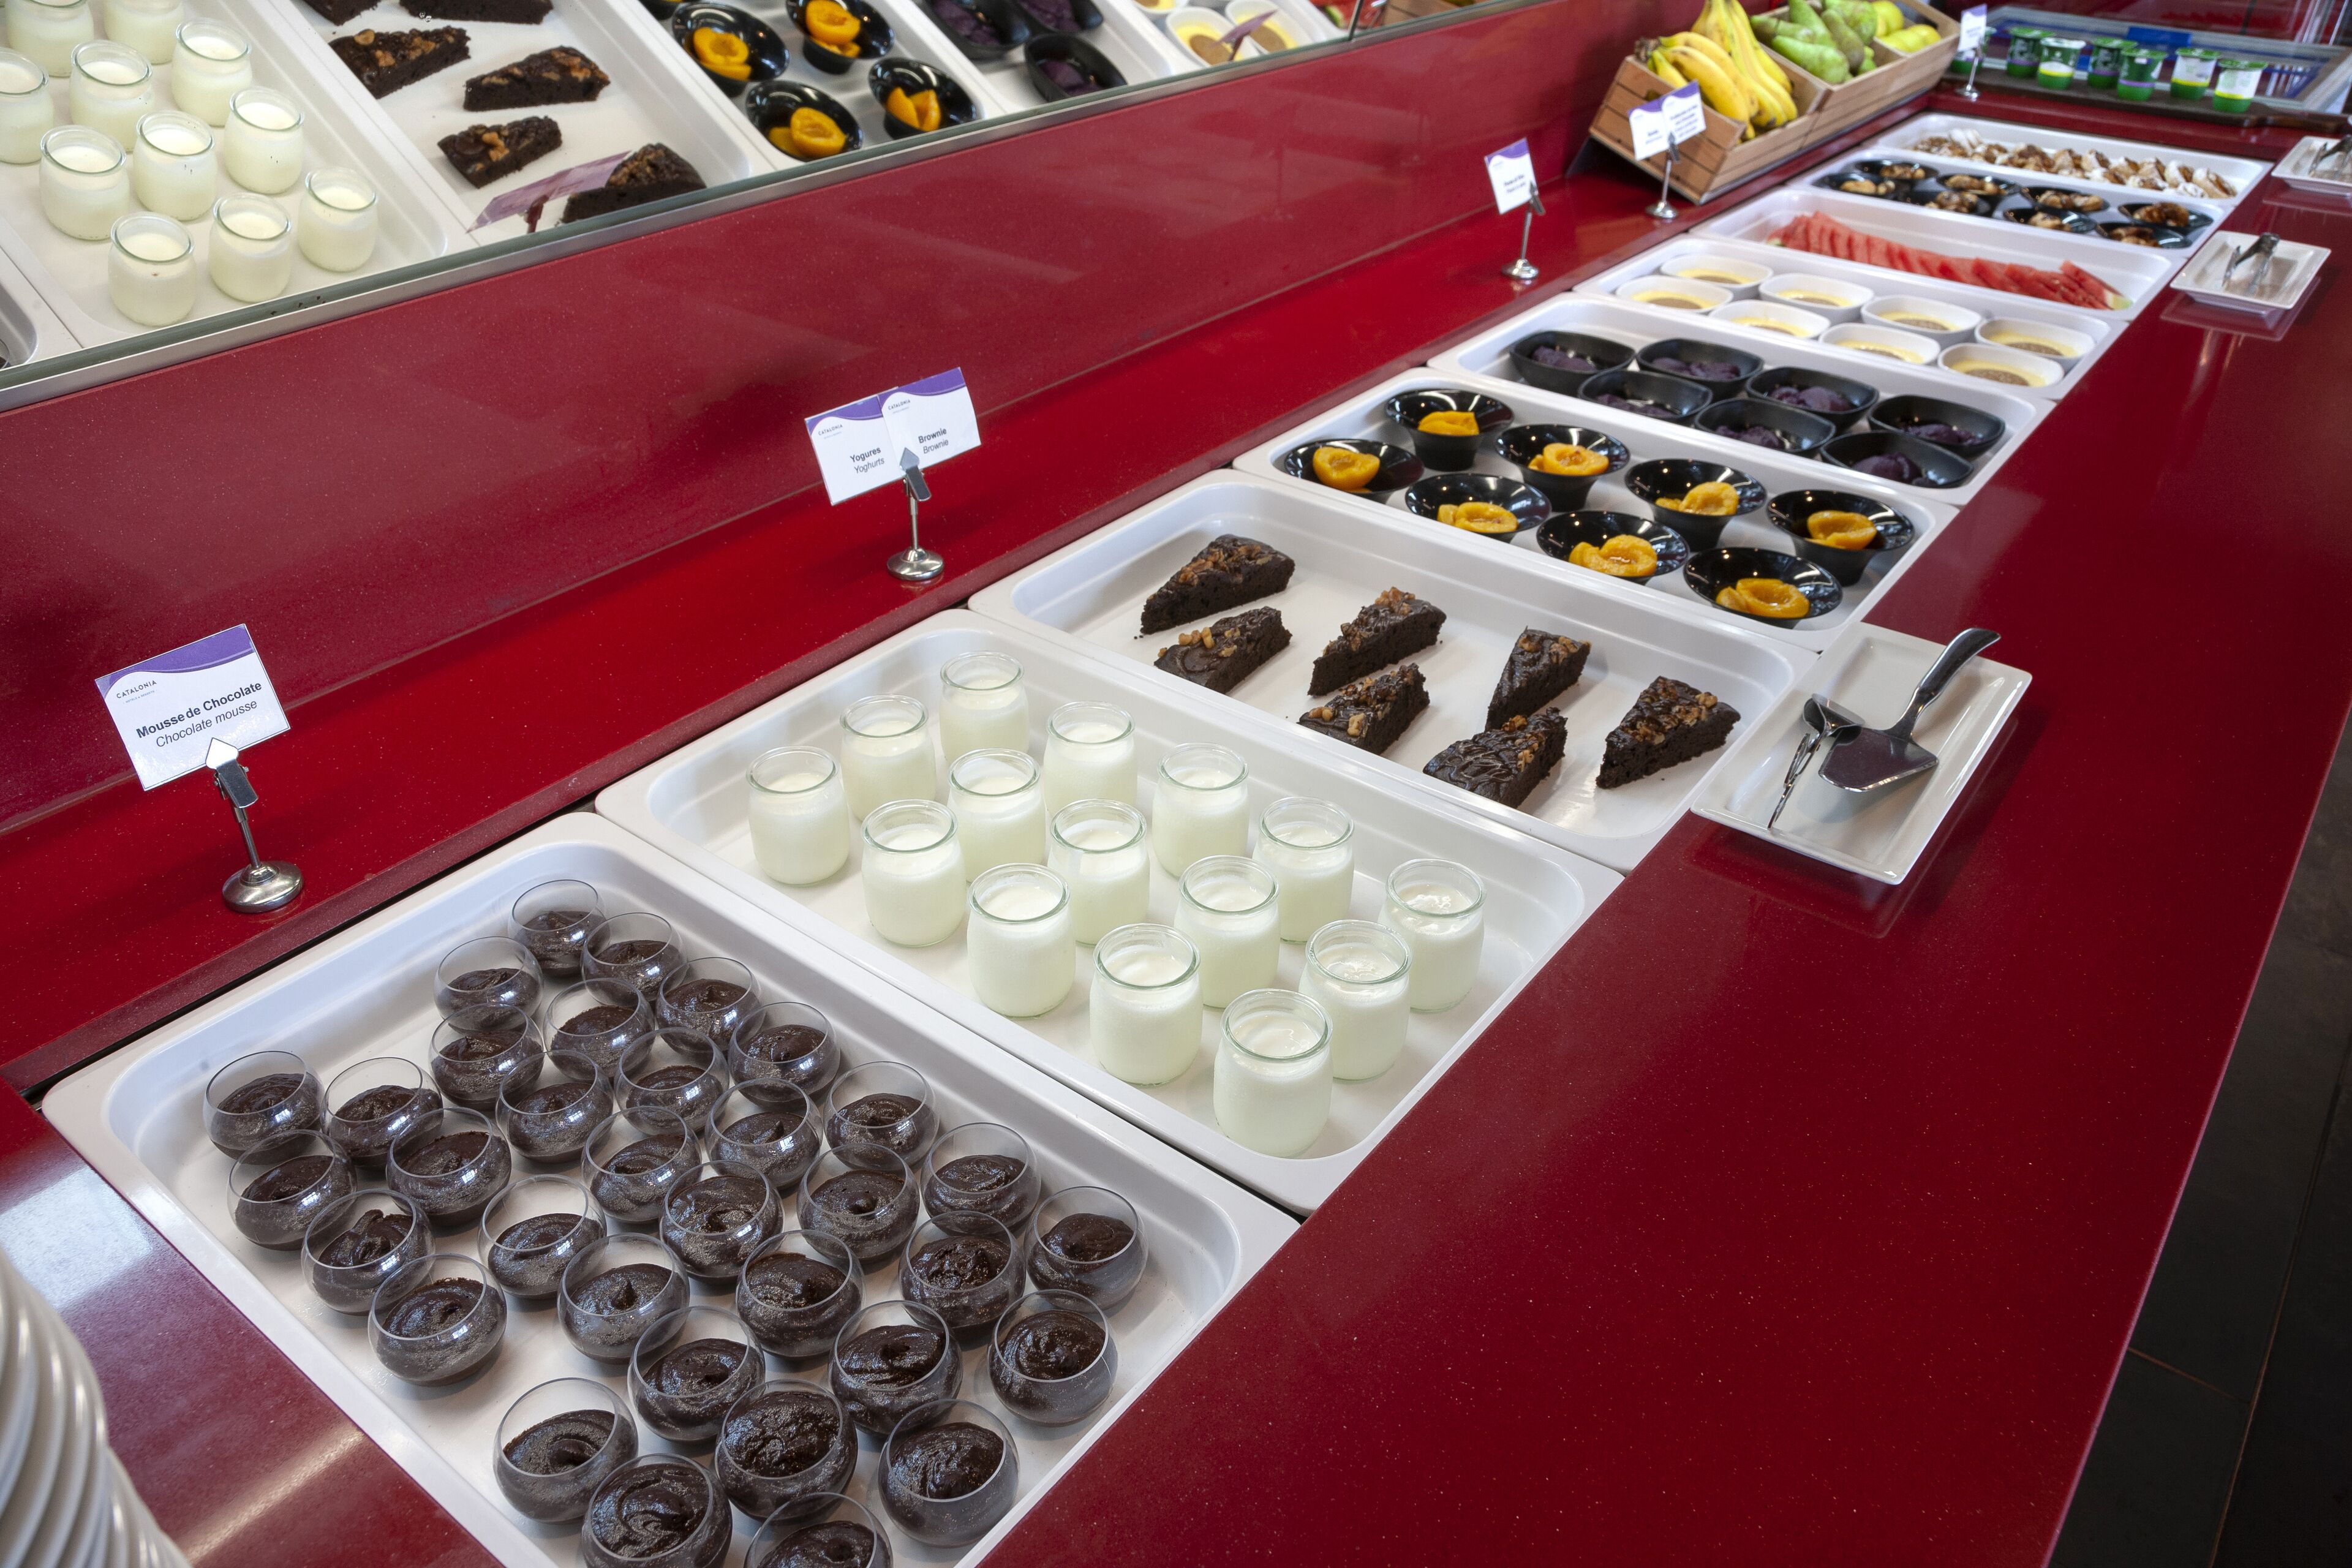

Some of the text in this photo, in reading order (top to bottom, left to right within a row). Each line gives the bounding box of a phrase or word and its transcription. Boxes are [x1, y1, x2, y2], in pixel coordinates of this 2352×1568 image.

[888, 399, 911, 410] CATALONIA
[818, 424, 843, 435] CATALONIA
[918, 428, 947, 443] Brownie
[923, 439, 949, 454] Brownie
[850, 447, 881, 463] Yogures
[854, 457, 884, 474] Yoghurts
[116, 680, 157, 699] CATALONIA
[136, 681, 262, 738] Mousse de Chocolate
[156, 700, 257, 747] Chocolate mousse
